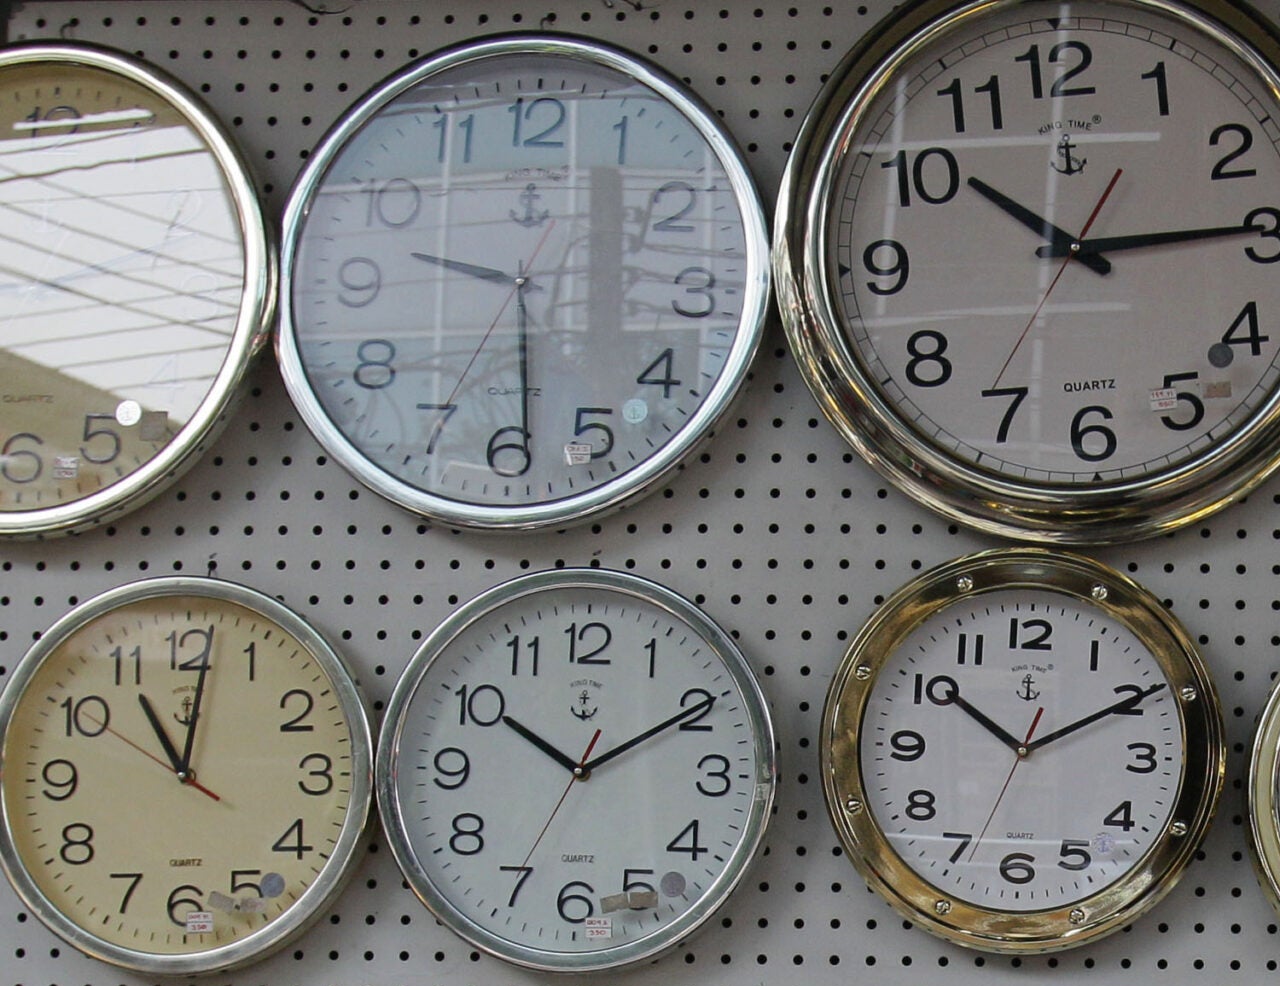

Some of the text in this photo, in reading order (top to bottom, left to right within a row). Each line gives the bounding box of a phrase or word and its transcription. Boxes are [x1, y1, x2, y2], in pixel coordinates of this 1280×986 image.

[1014, 41, 1096, 99] 12
[509, 98, 567, 148] 12
[937, 74, 1004, 133] 11
[433, 115, 475, 162] 11
[1038, 120, 1093, 135] KING TIME
[1208, 123, 1257, 180] 2
[880, 147, 960, 207] 10
[361, 177, 422, 229] 10
[862, 239, 910, 295] 9
[353, 339, 396, 389] 8
[637, 349, 681, 399] 4
[1063, 379, 1116, 392] QUARTZ
[79, 414, 122, 464] 5
[564, 622, 612, 664] 12
[1009, 618, 1053, 650] 12
[110, 646, 140, 685] 11
[507, 636, 539, 676] 11
[1031, 665, 1048, 673] TIME
[60, 695, 110, 737] 10
[280, 689, 314, 732] 2
[455, 684, 505, 727] 10
[890, 730, 925, 761] 9
[1126, 743, 1157, 774] 3
[298, 753, 333, 795] 3
[433, 747, 470, 790] 9
[905, 790, 936, 821] 8
[1104, 801, 1135, 831] 4
[272, 819, 313, 859] 4
[449, 813, 484, 856] 8
[170, 859, 202, 867] QUARTZ
[561, 855, 594, 863] QUARTZ
